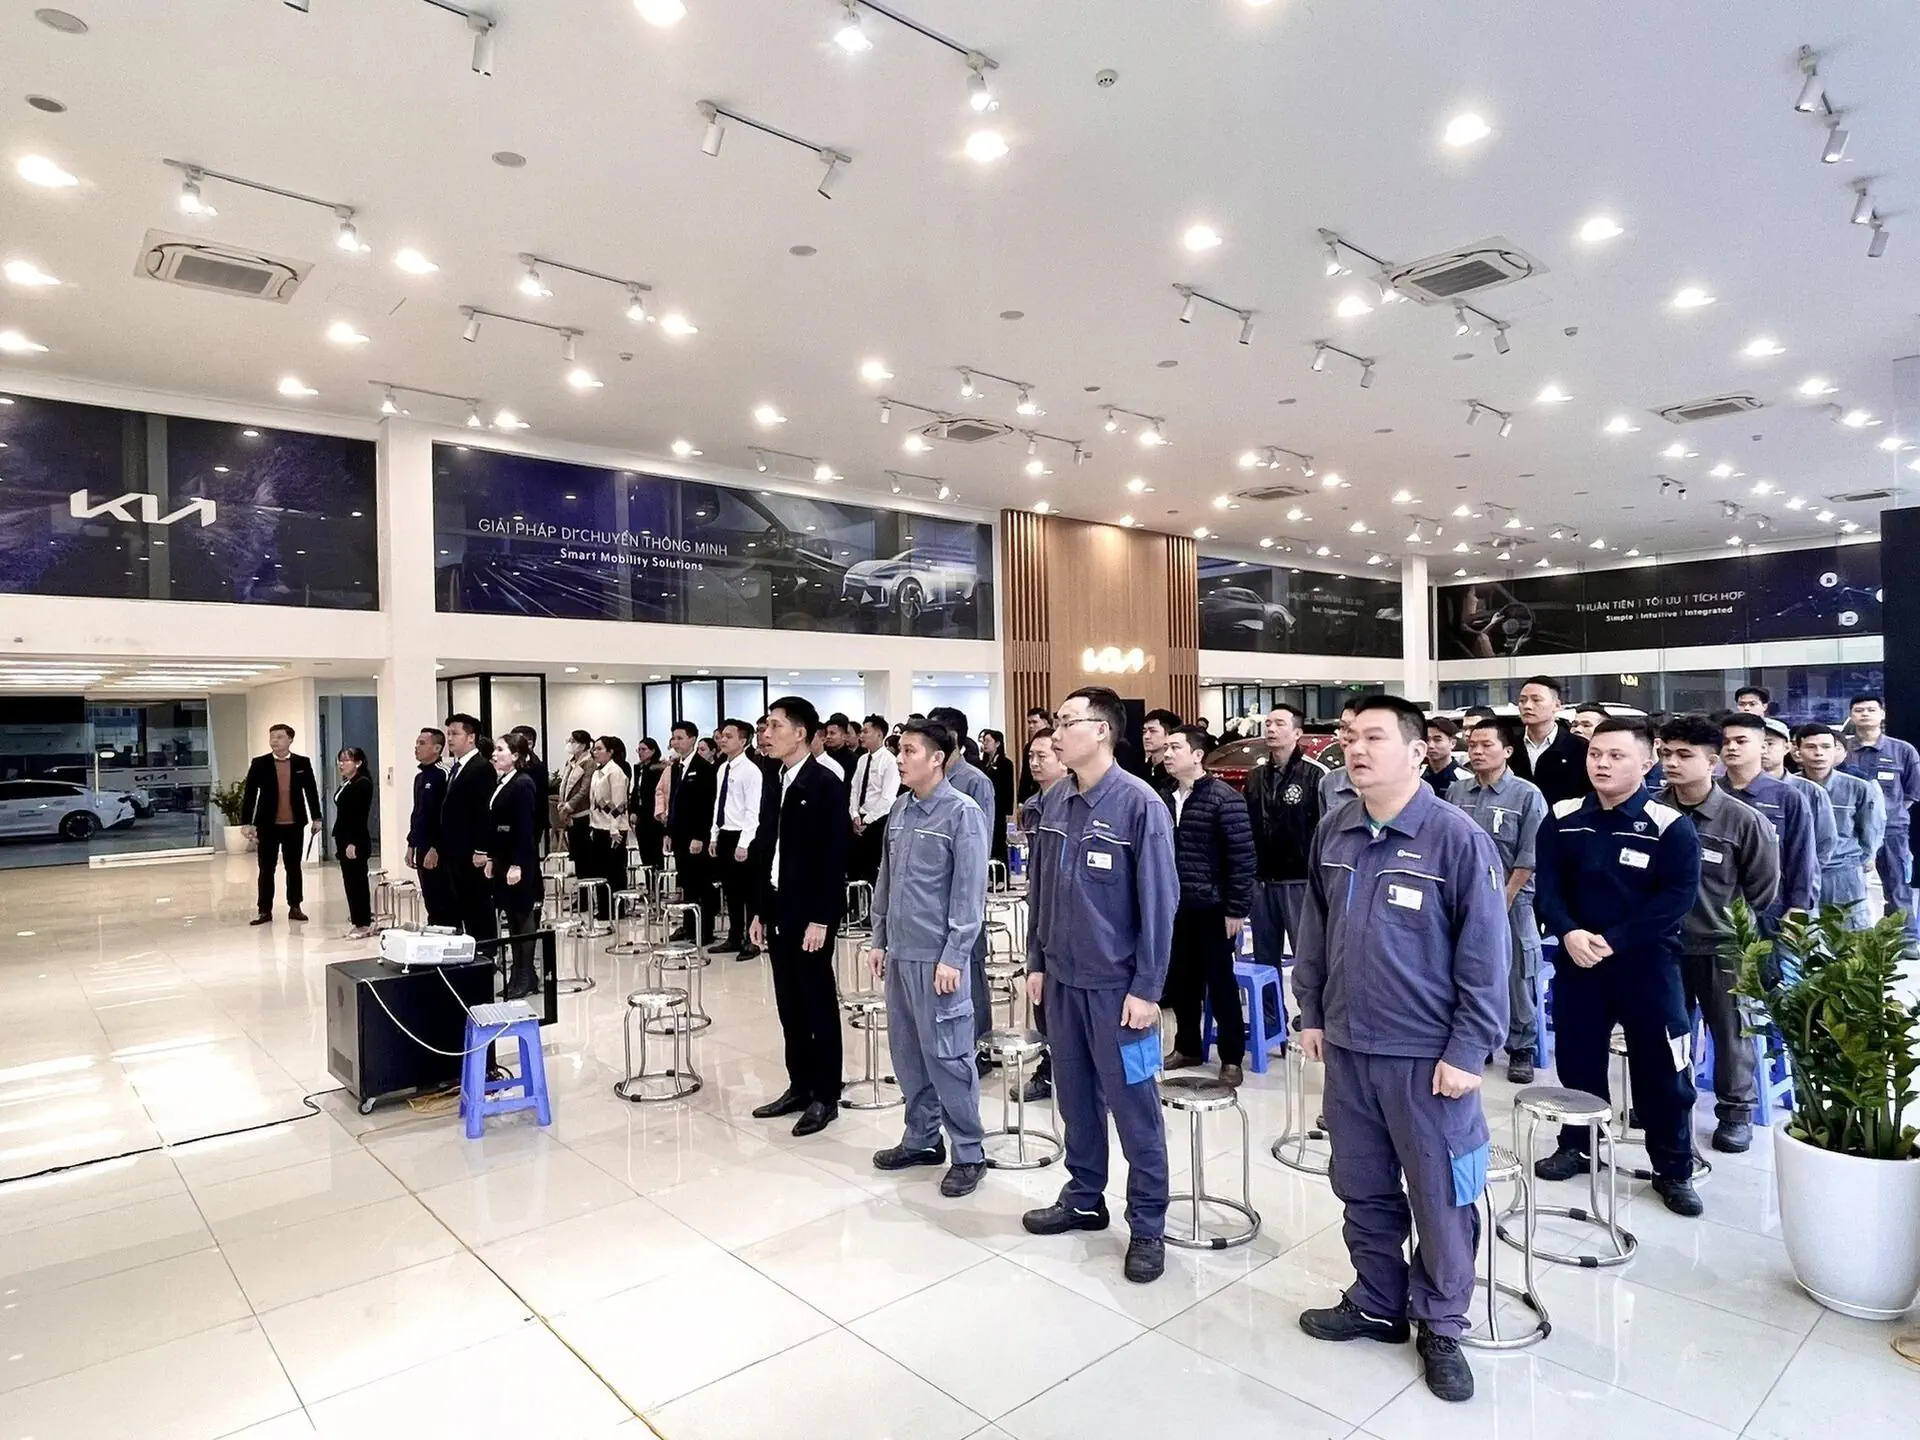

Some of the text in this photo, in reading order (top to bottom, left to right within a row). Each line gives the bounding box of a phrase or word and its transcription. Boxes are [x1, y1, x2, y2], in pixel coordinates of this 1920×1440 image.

[515, 522, 557, 538] PHÁP
[642, 535, 692, 553] THÔNG
[695, 541, 728, 556] MINH
[560, 547, 703, 572] Smart Mobility Solutions
[1605, 605, 1734, 622] Simple Intuitive Integrated
